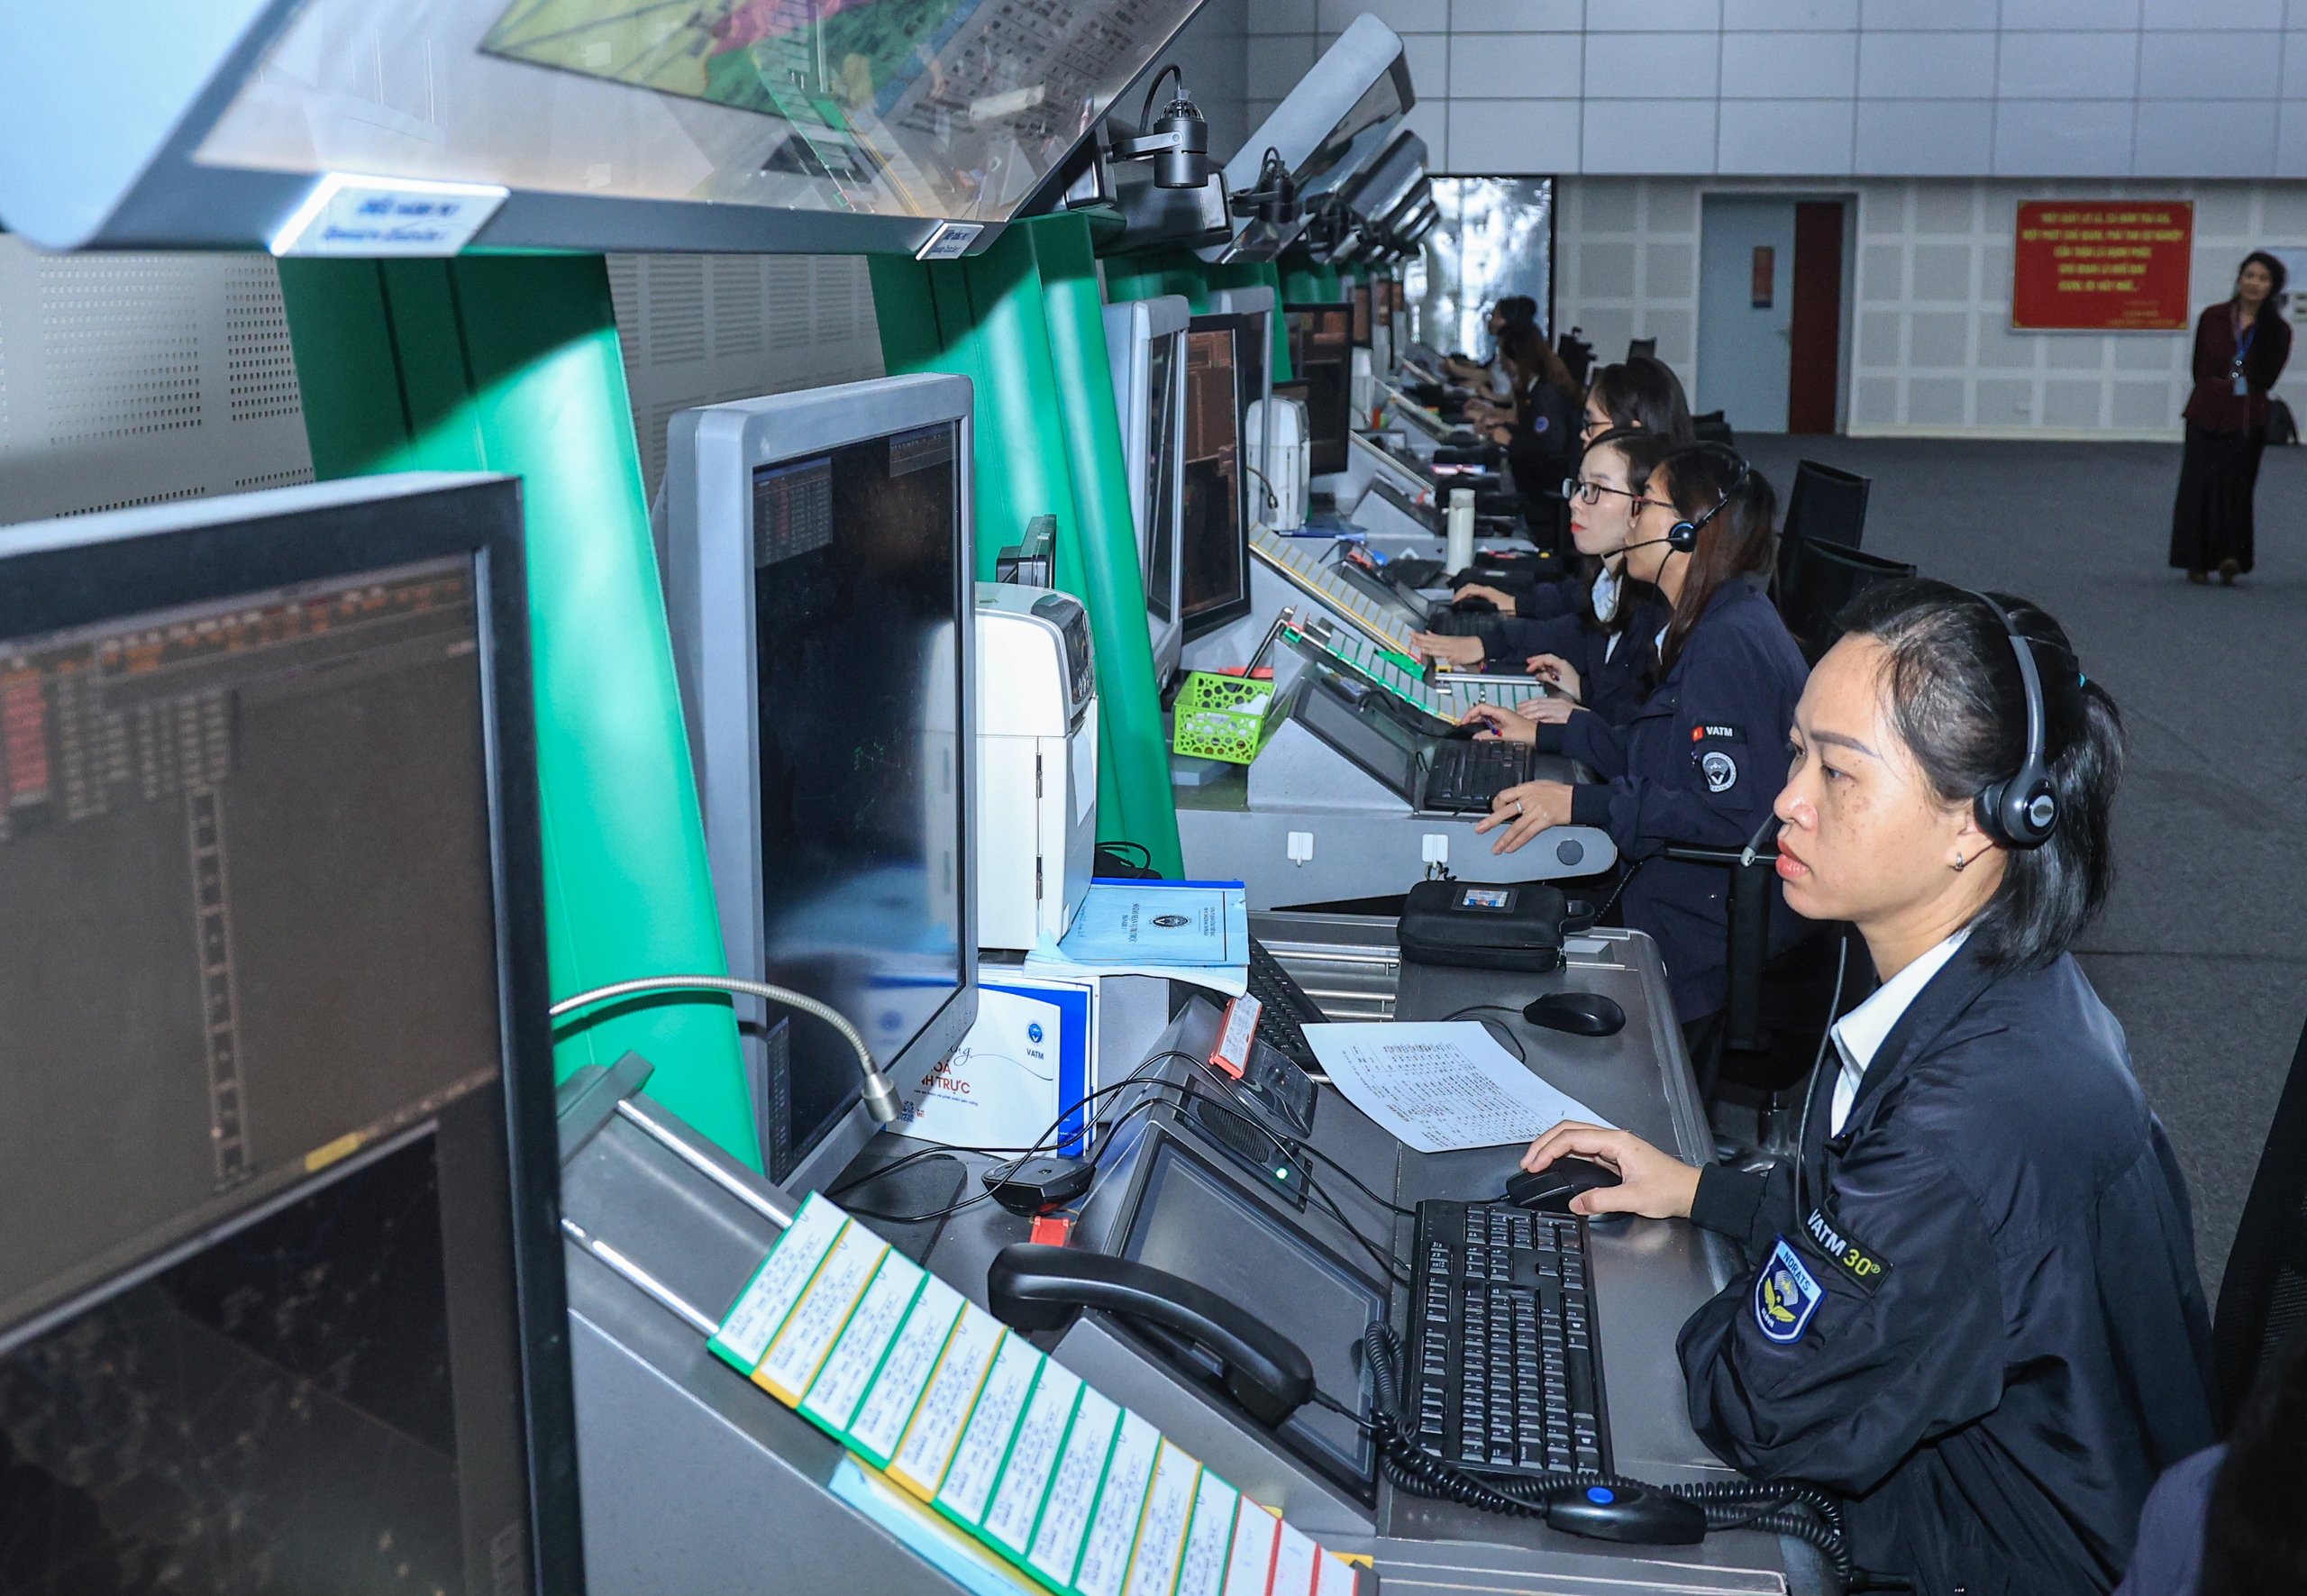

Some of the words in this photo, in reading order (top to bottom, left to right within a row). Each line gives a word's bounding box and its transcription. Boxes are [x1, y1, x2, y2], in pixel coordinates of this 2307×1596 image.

[1706, 726, 1733, 737] VATM
[1026, 1047, 1044, 1061] VATM
[933, 1059, 952, 1075] OÁ
[935, 1076, 971, 1094] TRỰC
[1806, 1208, 1847, 1257] VATM
[1783, 1251, 1811, 1292] NORATS
